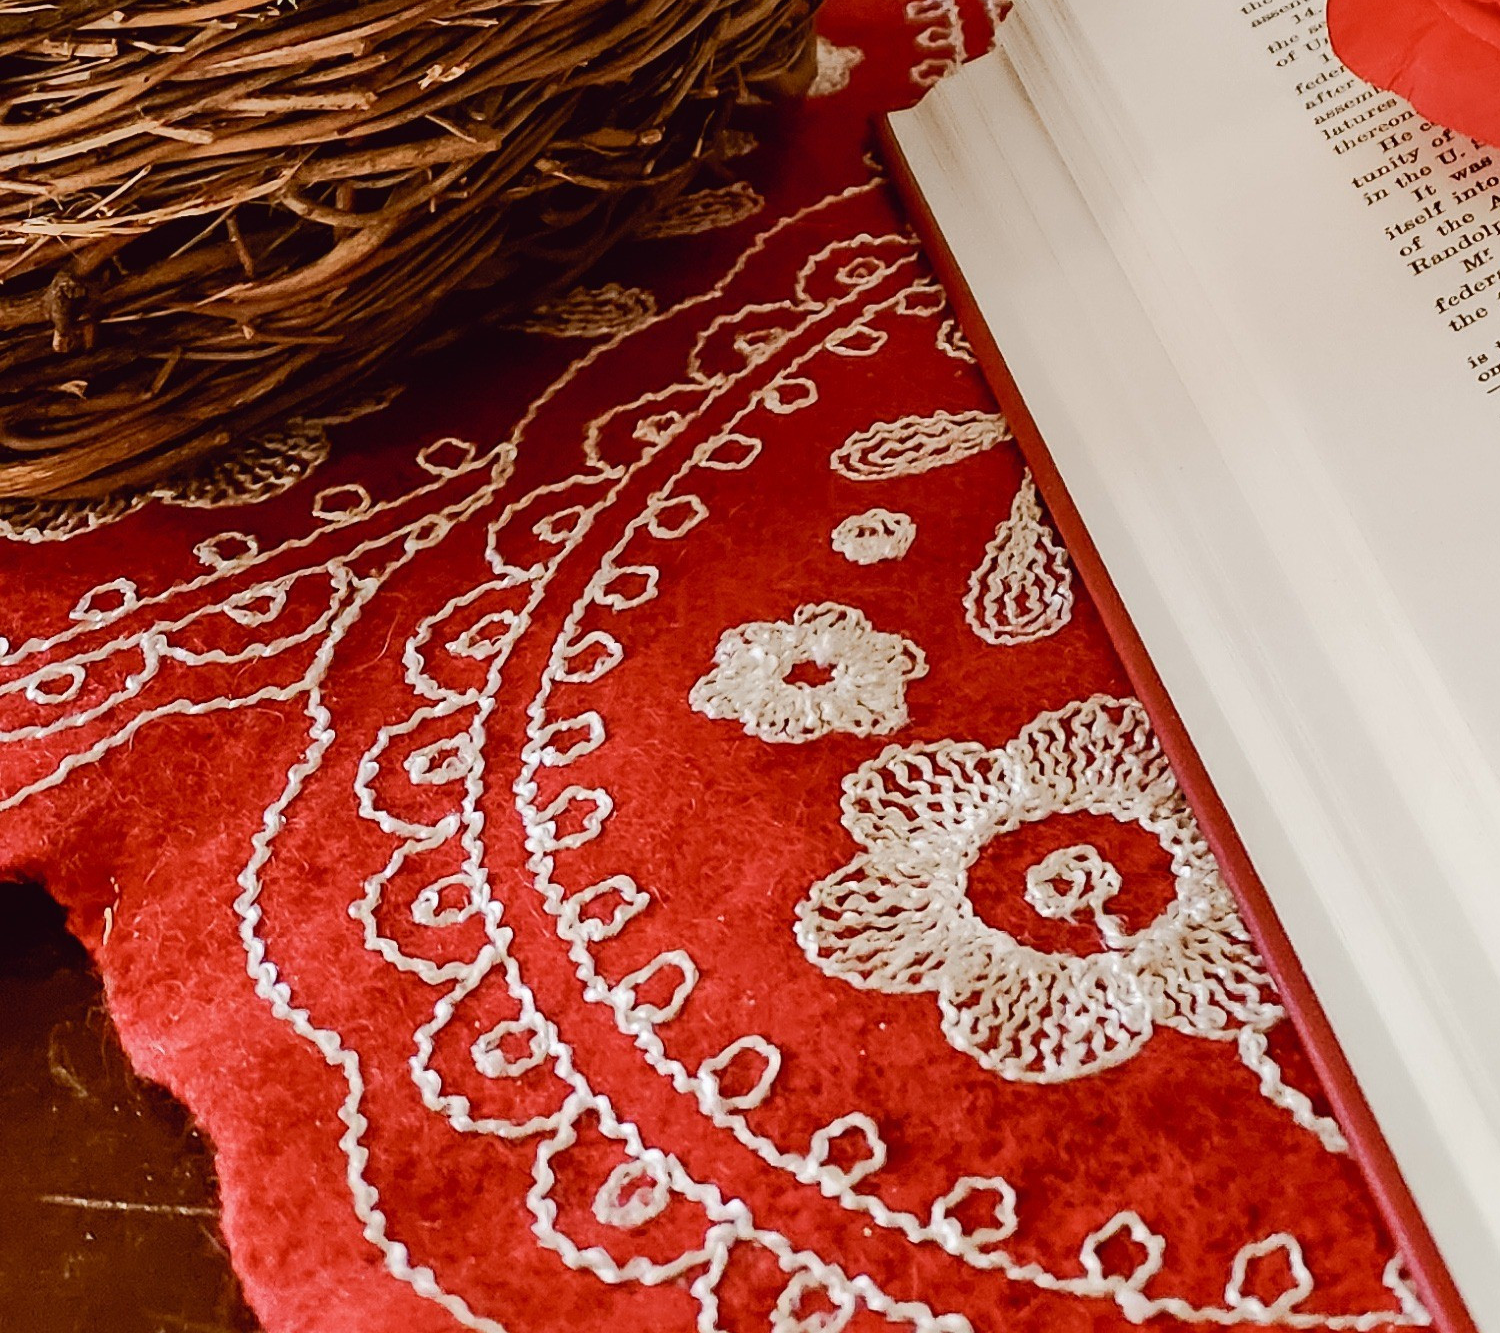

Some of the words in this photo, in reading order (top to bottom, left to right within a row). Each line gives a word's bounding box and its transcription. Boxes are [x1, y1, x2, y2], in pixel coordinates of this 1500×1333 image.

[1305, 78, 1354, 110] after
[1322, 98, 1397, 140] latures
[1352, 147, 1419, 188] tunity
[1430, 127, 1454, 148] of
[1377, 131, 1413, 153] He
[1363, 188, 1388, 206] in
[1394, 165, 1432, 188] the
[1410, 184, 1436, 202] It
[1448, 155, 1492, 181] was
[1384, 200, 1445, 240] itself
[1451, 175, 1499, 204] into
[1399, 235, 1424, 256] of
[1436, 212, 1474, 236] the
[1448, 306, 1488, 332] the
[1467, 353, 1488, 369] is
